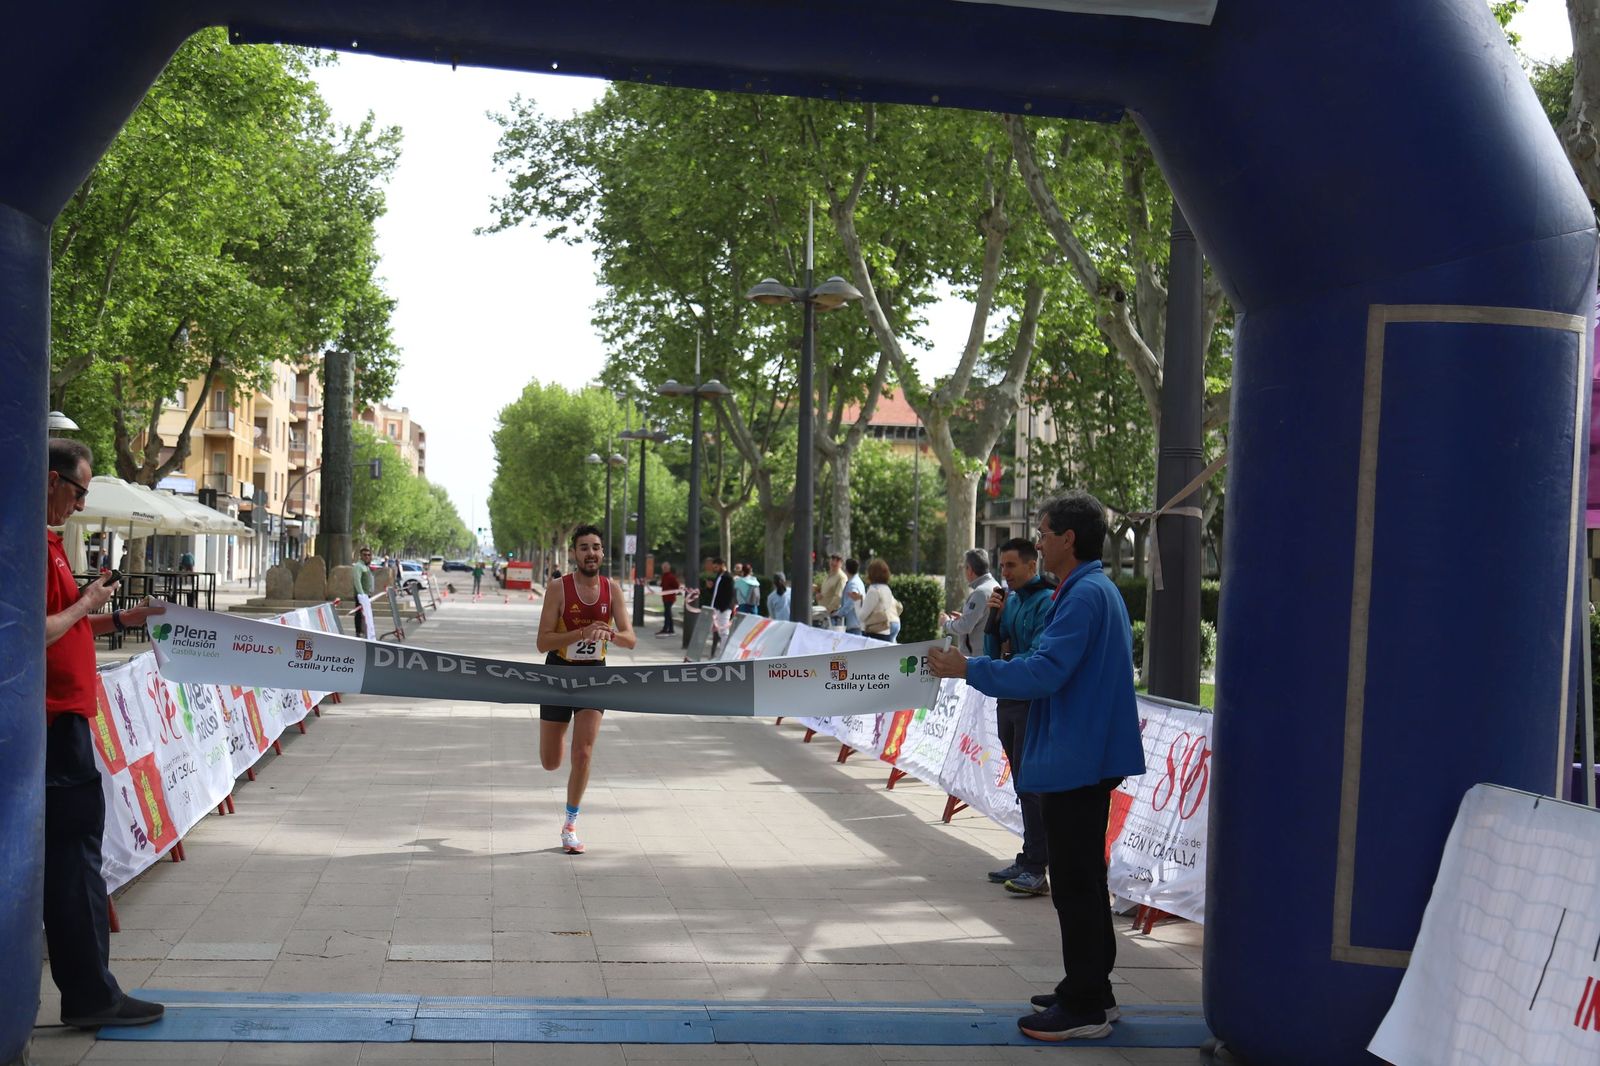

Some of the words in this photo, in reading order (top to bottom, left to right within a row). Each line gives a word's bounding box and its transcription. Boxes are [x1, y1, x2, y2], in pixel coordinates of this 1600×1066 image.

[174, 625, 217, 641] Plena
[234, 634, 254, 643] NOS
[172, 638, 216, 649] inclusión
[576, 641, 596, 655] 25
[314, 654, 343, 665] Junta
[345, 656, 356, 665] de
[287, 660, 321, 671] Castilla
[322, 664, 329, 673] y
[330, 662, 354, 673] León
[437, 656, 477, 675] DE
[485, 664, 628, 689] CASTILLA
[634, 671, 653, 683] Y
[663, 664, 746, 683] LEÓN
[850, 673, 876, 681] Junta
[878, 673, 890, 681] de
[825, 682, 857, 690] Castilla
[859, 684, 865, 692] y
[867, 682, 890, 690] León
[1123, 832, 1146, 852] LEÓN
